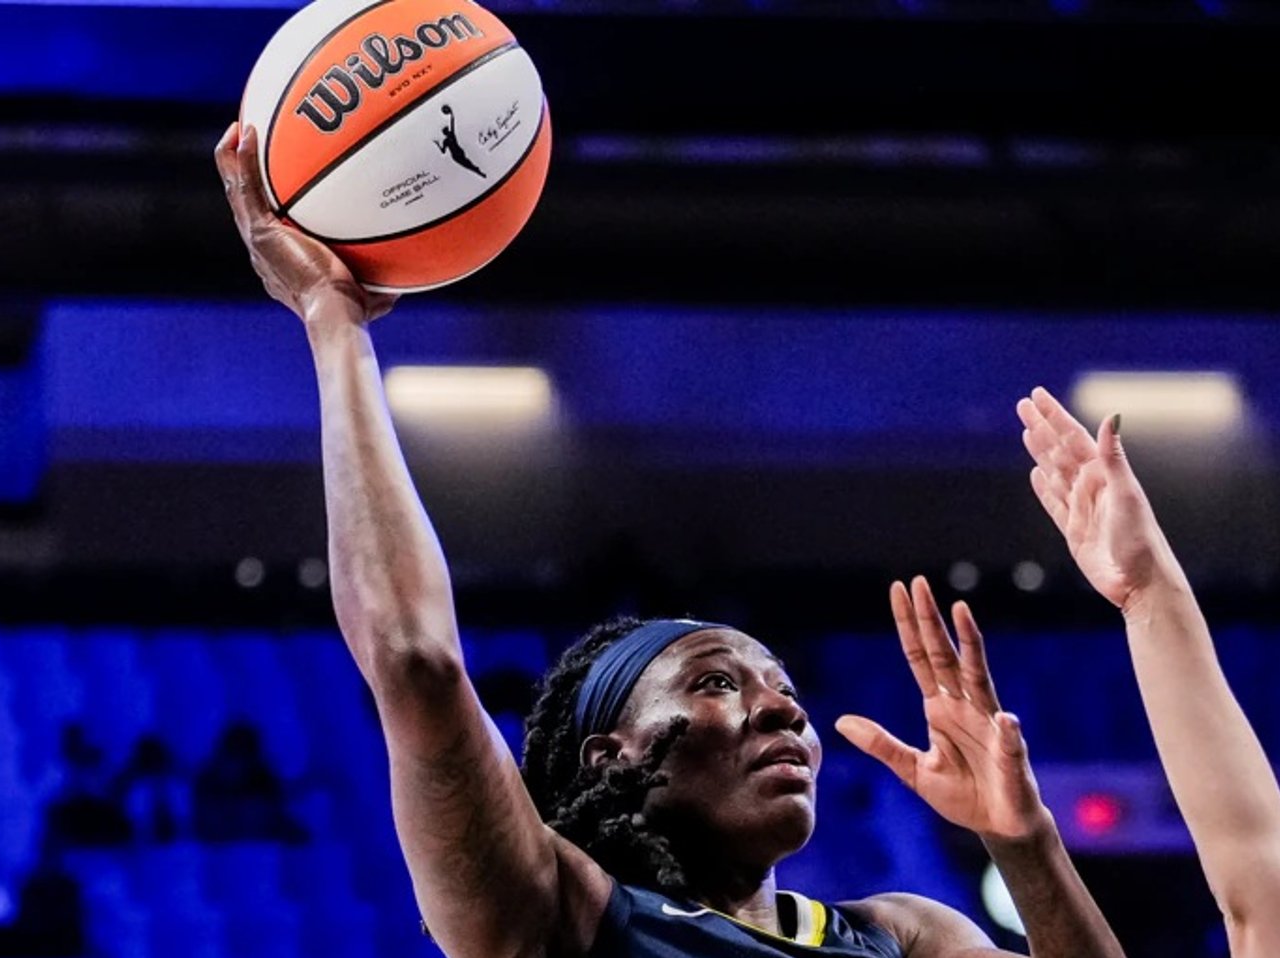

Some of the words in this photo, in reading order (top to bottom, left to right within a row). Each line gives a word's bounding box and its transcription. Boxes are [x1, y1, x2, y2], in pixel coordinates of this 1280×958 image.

[296, 11, 485, 134] Wilson
[380, 189, 412, 209] GAME
[413, 175, 441, 194] BALL
[382, 170, 431, 198] OFFICIAL
